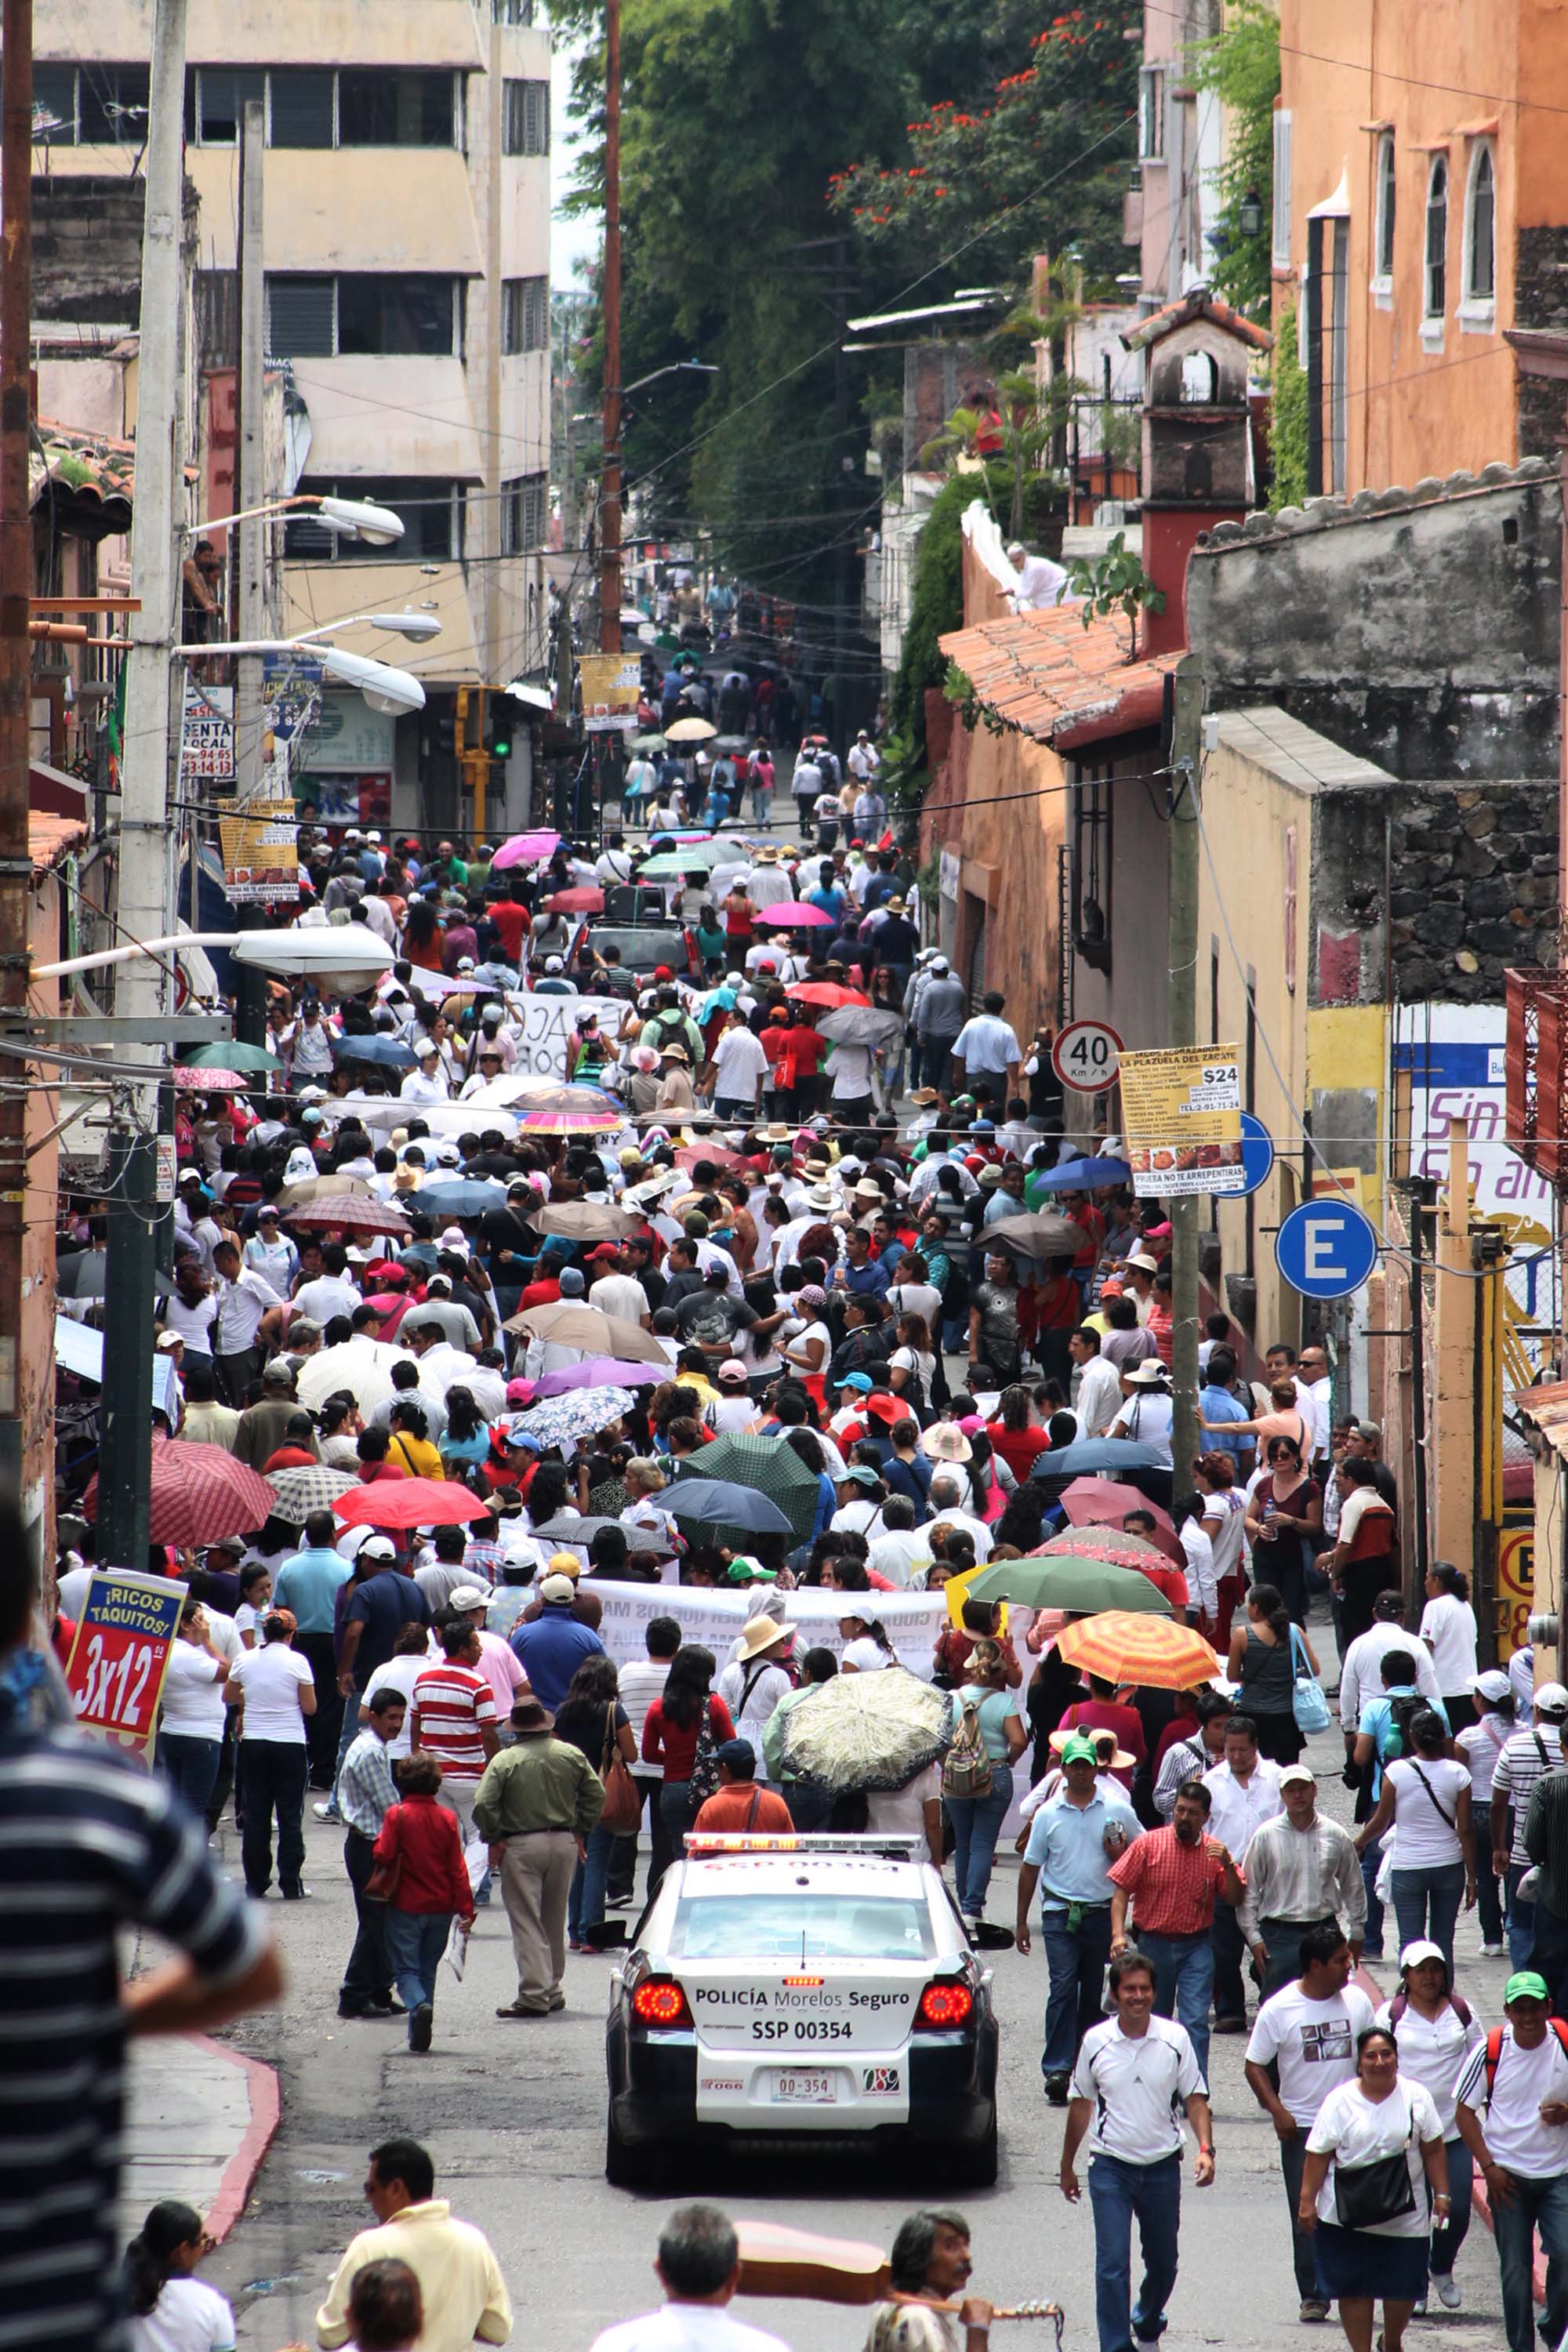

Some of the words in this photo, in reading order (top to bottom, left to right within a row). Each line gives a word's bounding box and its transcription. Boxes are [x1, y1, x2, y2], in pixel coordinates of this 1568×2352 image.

[1070, 1036, 1108, 1065] 40
[1134, 1056, 1181, 1066] PLAZUELA
[1203, 1052, 1236, 1061] ZACATE
[1203, 1068, 1238, 1084] $24
[1421, 1092, 1500, 1140] Sin
[601, 1134, 620, 1145] NY
[1164, 1173, 1175, 1181] NO
[1187, 1167, 1242, 1181] ARREPENTIRAS
[1305, 1219, 1347, 1279] E
[91, 1607, 169, 1636] TAQUITOS!
[696, 1987, 768, 2005] POLICÍA
[775, 1991, 842, 2007] Morelos
[849, 1991, 909, 2010] Seguro
[753, 2020, 789, 2039] SSP
[794, 2021, 852, 2039] 00354
[779, 2078, 828, 2092] 00-354
